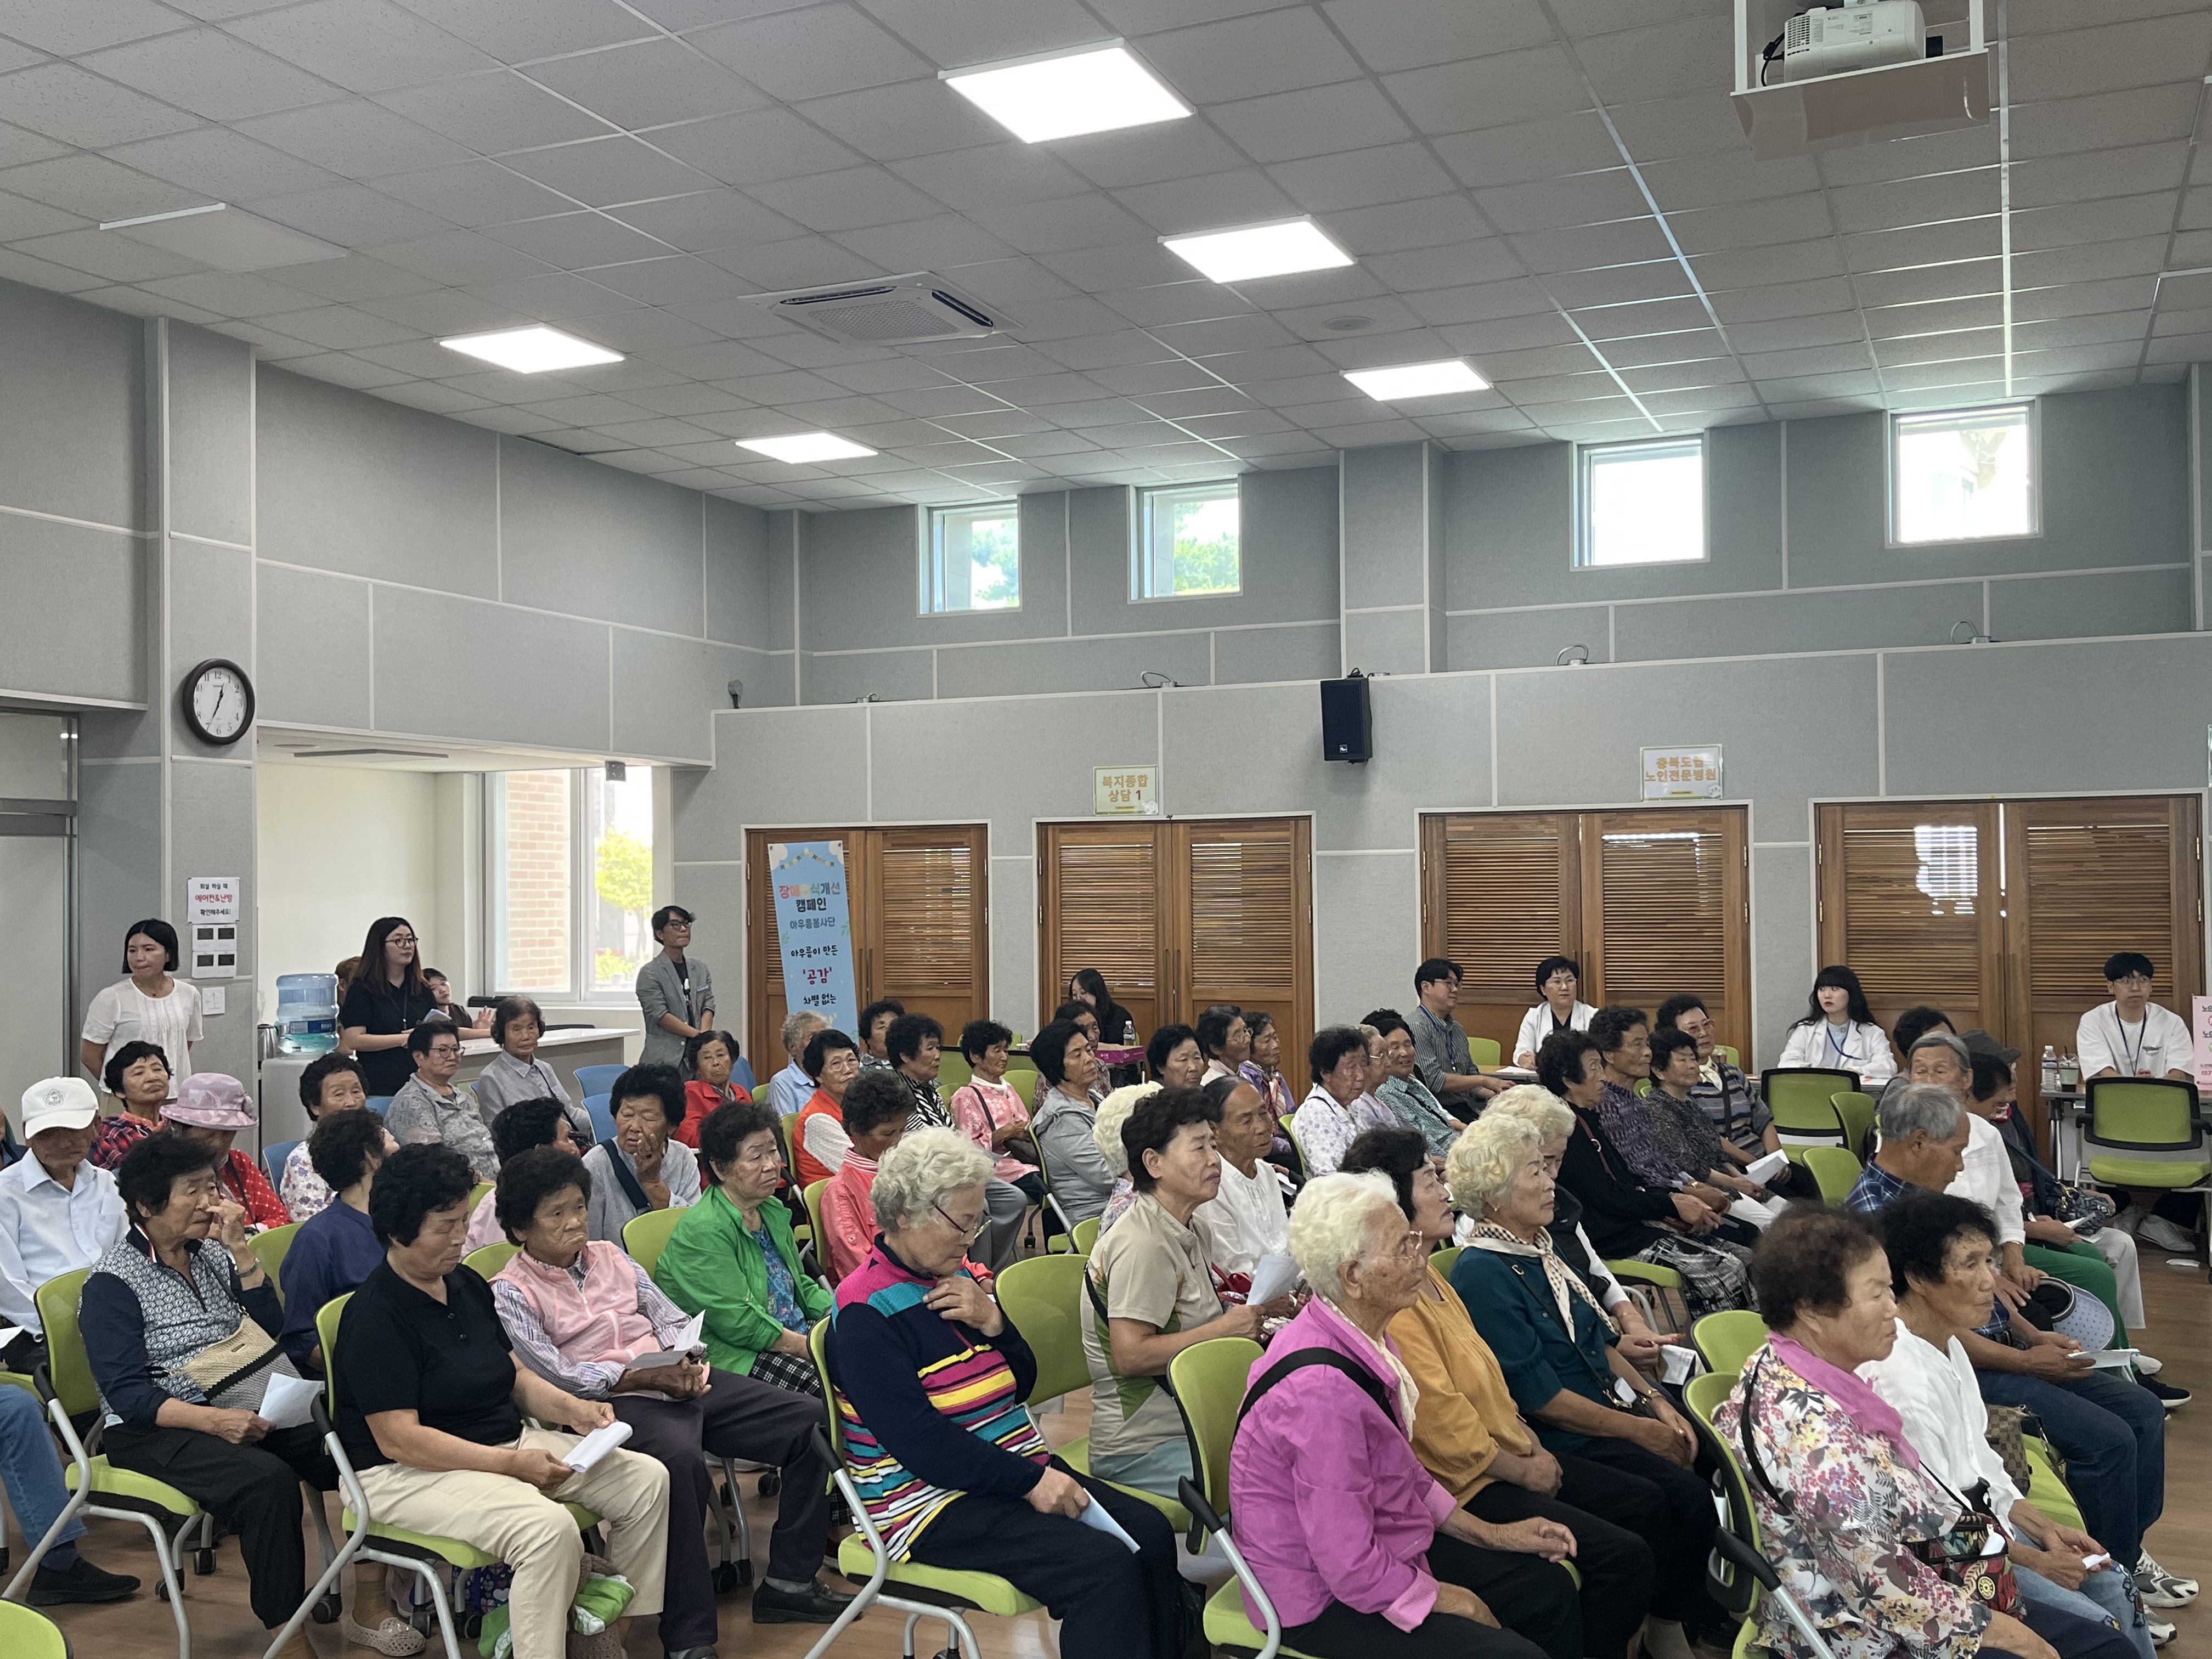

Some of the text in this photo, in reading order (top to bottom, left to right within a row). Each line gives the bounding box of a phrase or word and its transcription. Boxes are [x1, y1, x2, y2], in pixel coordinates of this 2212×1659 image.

[204, 673, 210, 681] 11
[215, 670, 222, 679] 12
[228, 675, 231, 683] 1
[196, 683, 202, 692] 10
[235, 685, 239, 693] 2
[238, 699, 242, 707] 3
[197, 711, 201, 719] 8
[235, 713, 239, 721] 4
[216, 726, 221, 735] 6
[227, 723, 232, 731] 5
[1645, 768, 1716, 782] 노인전문병원
[1102, 774, 1149, 788] 복지종합
[1109, 789, 1141, 802] 상담 1
[195, 894, 233, 902] 에어컨&난방
[796, 898, 826, 912] 캠페인
[790, 917, 836, 929] 아우름봉사단
[791, 945, 838, 958] 아우름이 만든
[803, 967, 832, 985] '공감'
[803, 993, 837, 1007] 차별 없는
